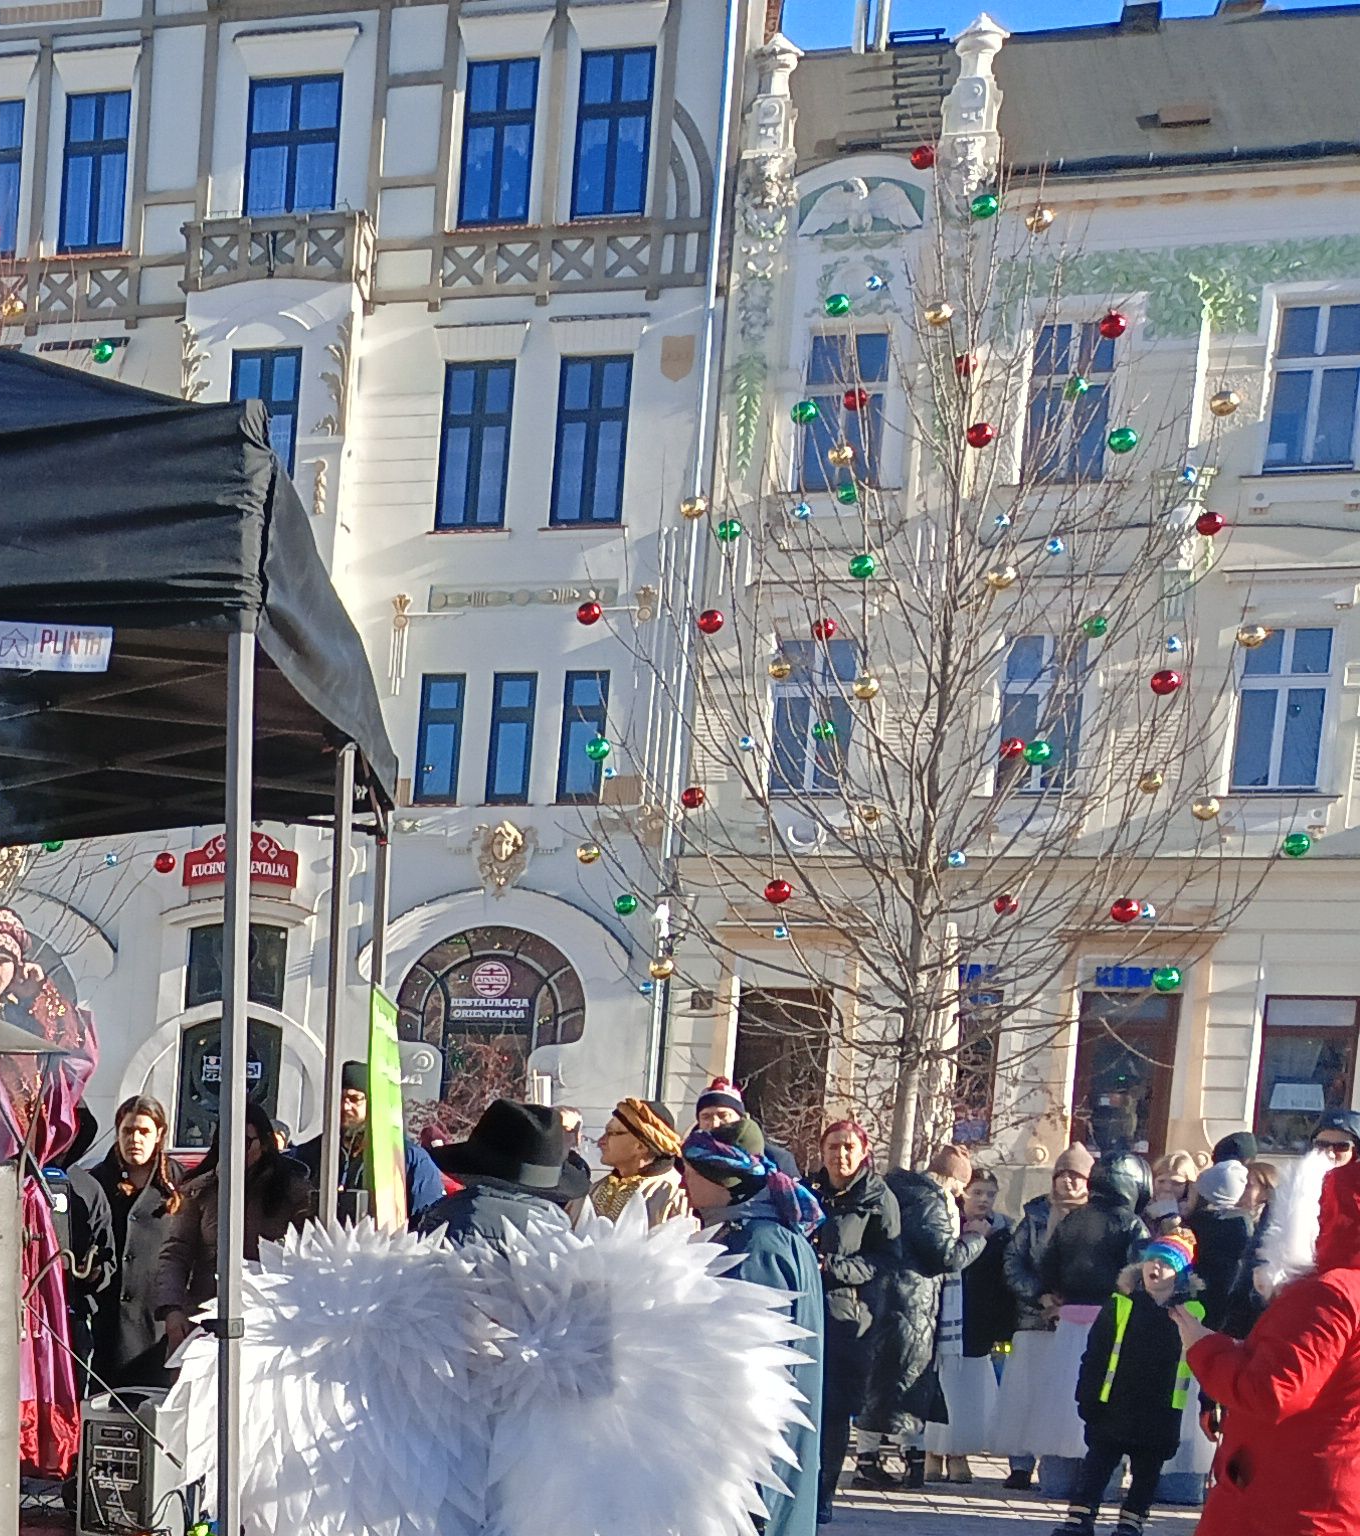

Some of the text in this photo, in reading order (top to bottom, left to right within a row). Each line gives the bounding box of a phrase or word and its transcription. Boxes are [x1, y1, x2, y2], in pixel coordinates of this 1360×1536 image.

[40, 629, 102, 656] PLINTH
[191, 860, 225, 878] KUCHNI
[450, 998, 529, 1008] RESTAURACJA
[452, 1010, 525, 1018] ORIENTALNA
